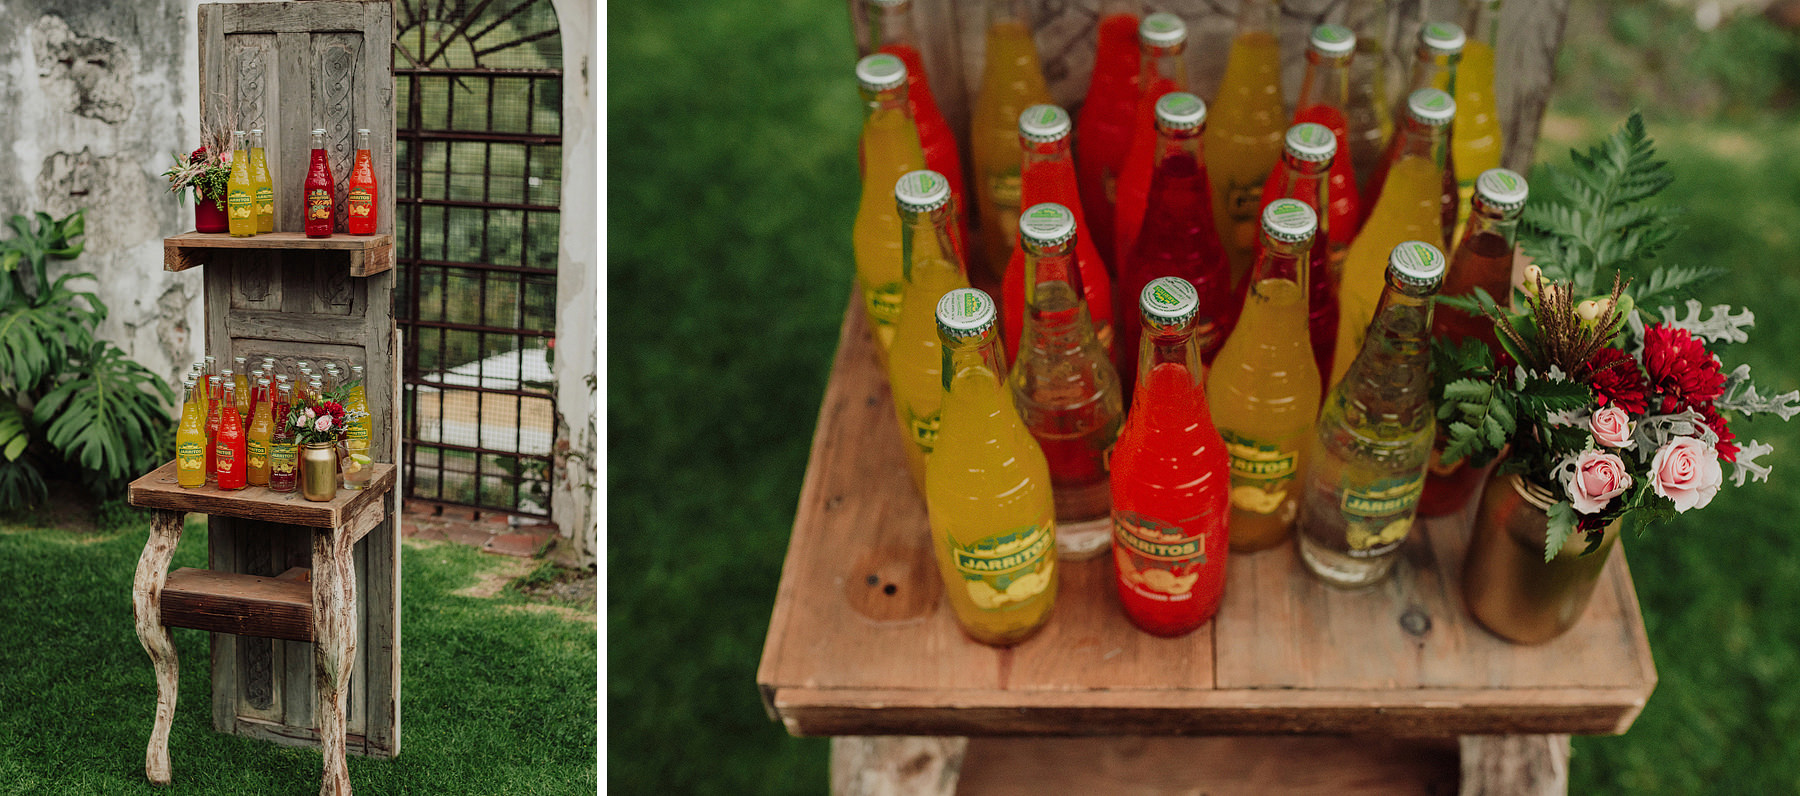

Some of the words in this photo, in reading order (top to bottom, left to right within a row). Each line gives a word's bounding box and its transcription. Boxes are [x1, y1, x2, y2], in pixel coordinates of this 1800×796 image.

[1232, 459, 1289, 475] RITOS
[1347, 492, 1420, 511] JARRIT
[962, 532, 1050, 570] JARRITOS
